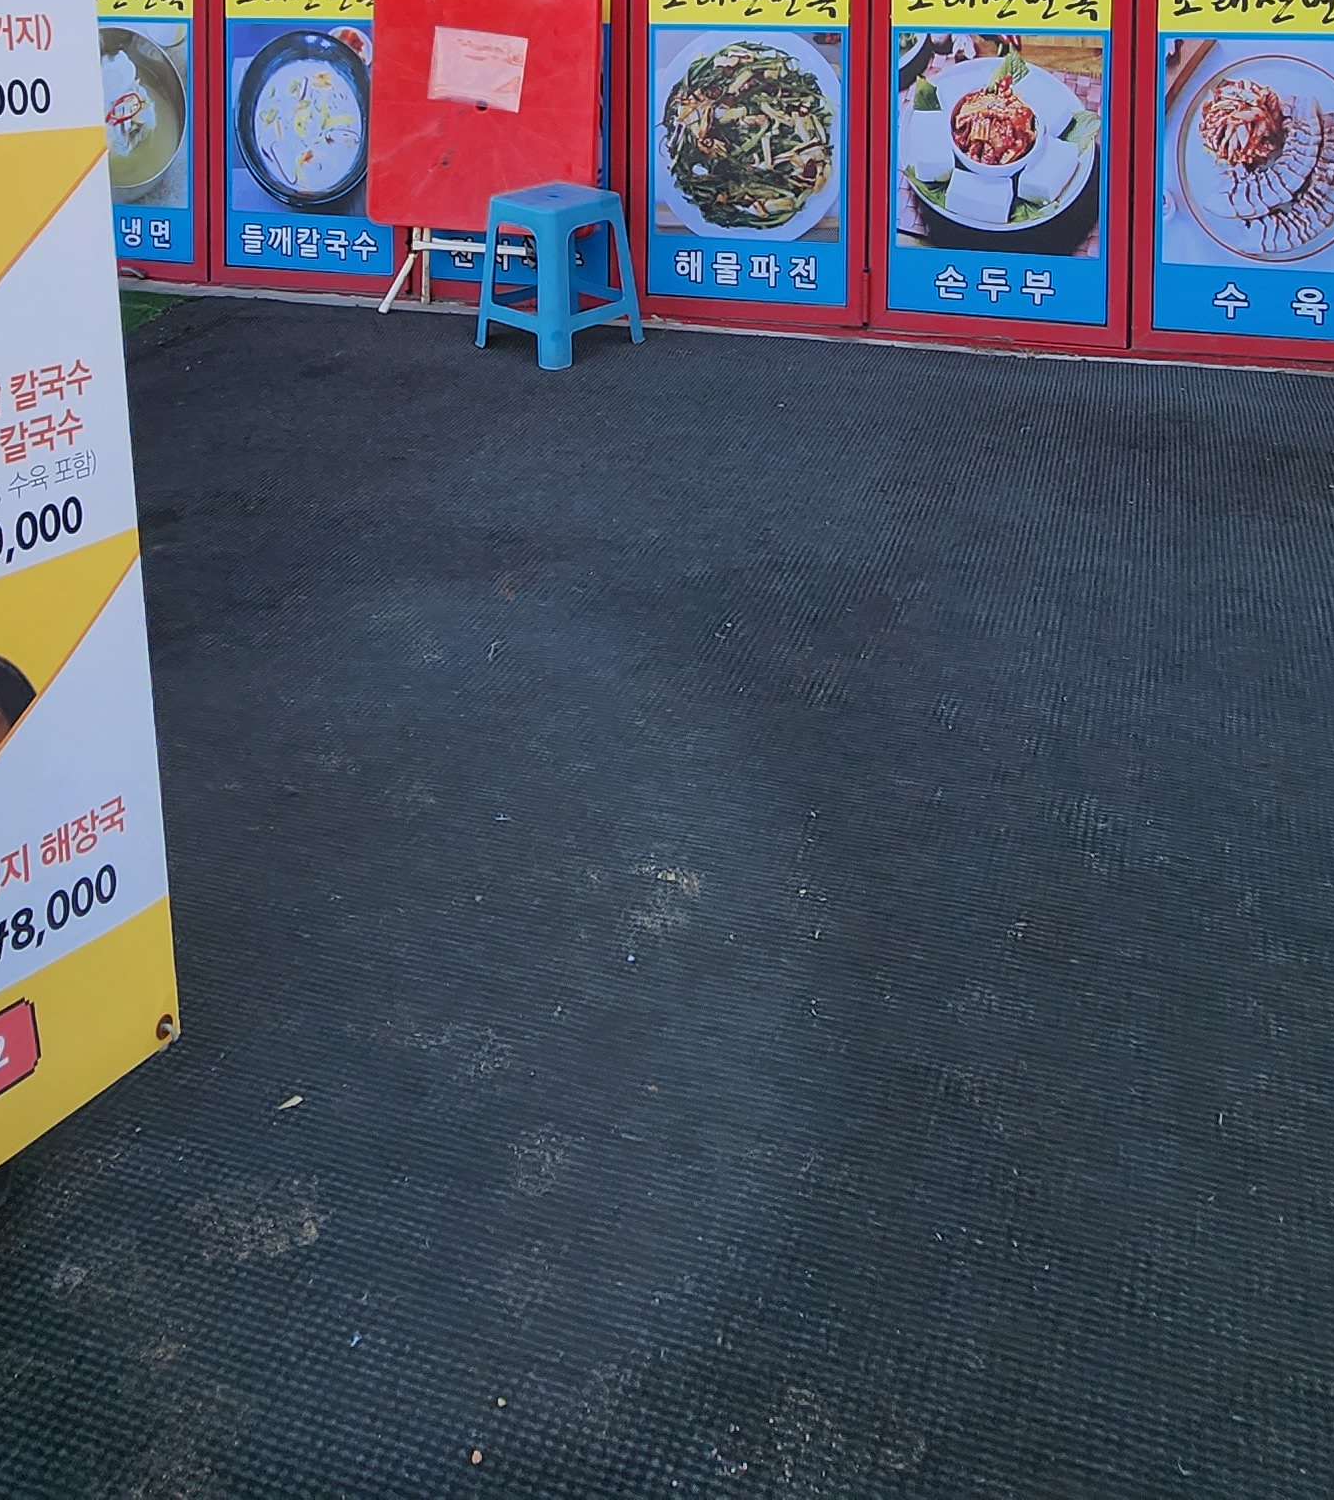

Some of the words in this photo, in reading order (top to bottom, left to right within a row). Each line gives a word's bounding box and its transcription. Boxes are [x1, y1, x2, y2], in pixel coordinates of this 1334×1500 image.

[240, 223, 379, 263] 들깨칼국수
[673, 249, 819, 290] 해물파전
[934, 264, 1056, 305] 손두부
[10, 358, 93, 412] 칼국수
[0, 408, 84, 465] 칼국수
[7, 464, 49, 499] 수육
[54, 449, 98, 486] 포함)
[39, 794, 127, 868] 해장국
